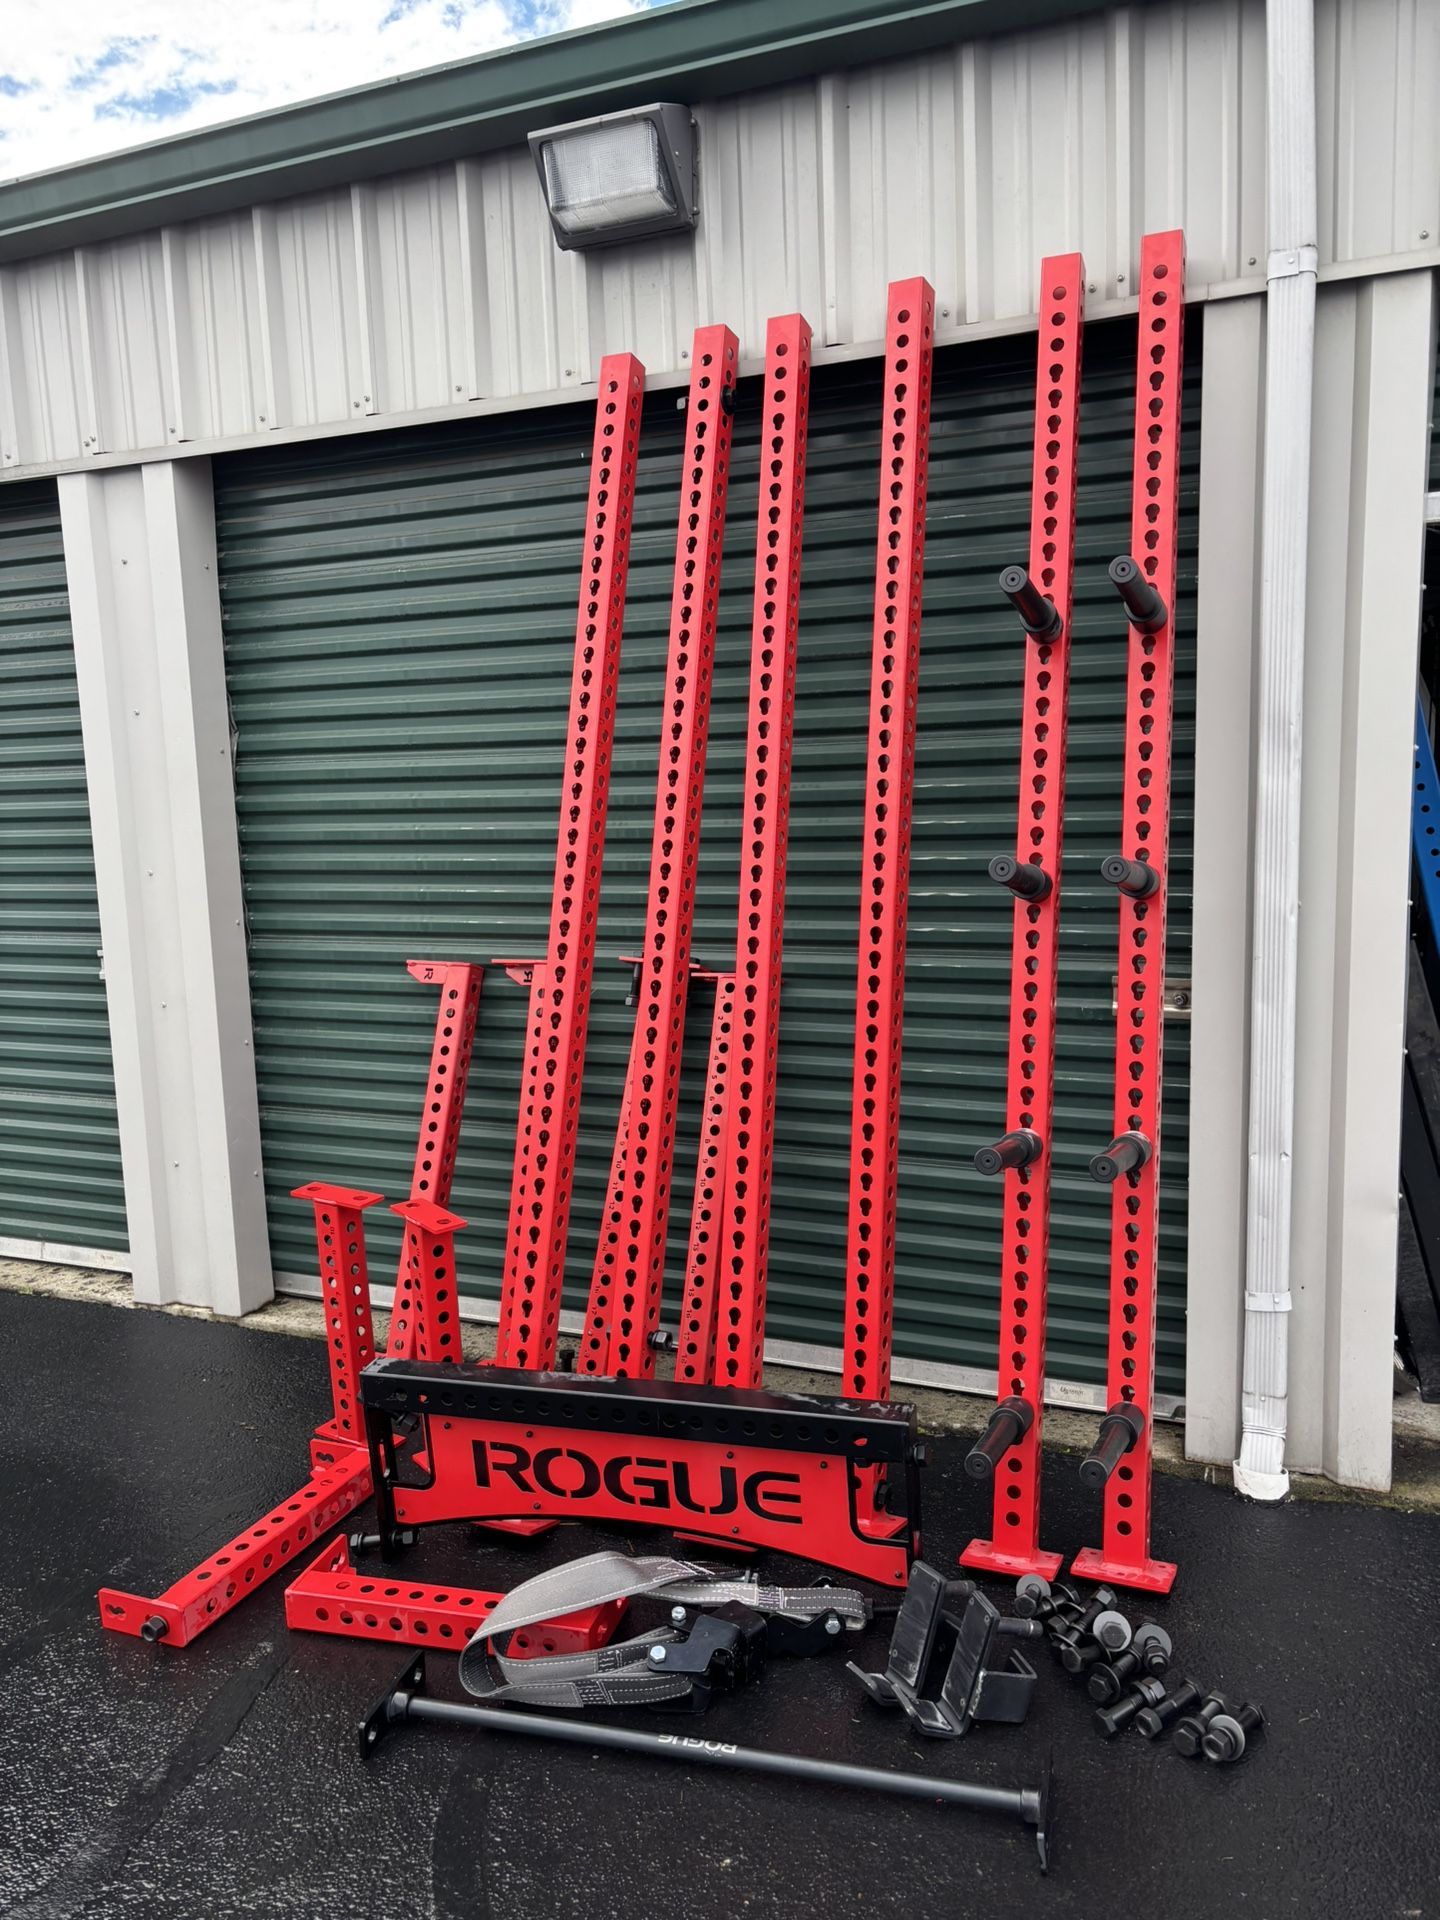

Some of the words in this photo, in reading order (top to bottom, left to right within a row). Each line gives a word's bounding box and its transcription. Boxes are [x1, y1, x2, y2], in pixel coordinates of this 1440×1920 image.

[424, 968, 433, 980] R
[472, 1439, 804, 1525] ROGUE
[658, 1734, 738, 1754] ROGUE
